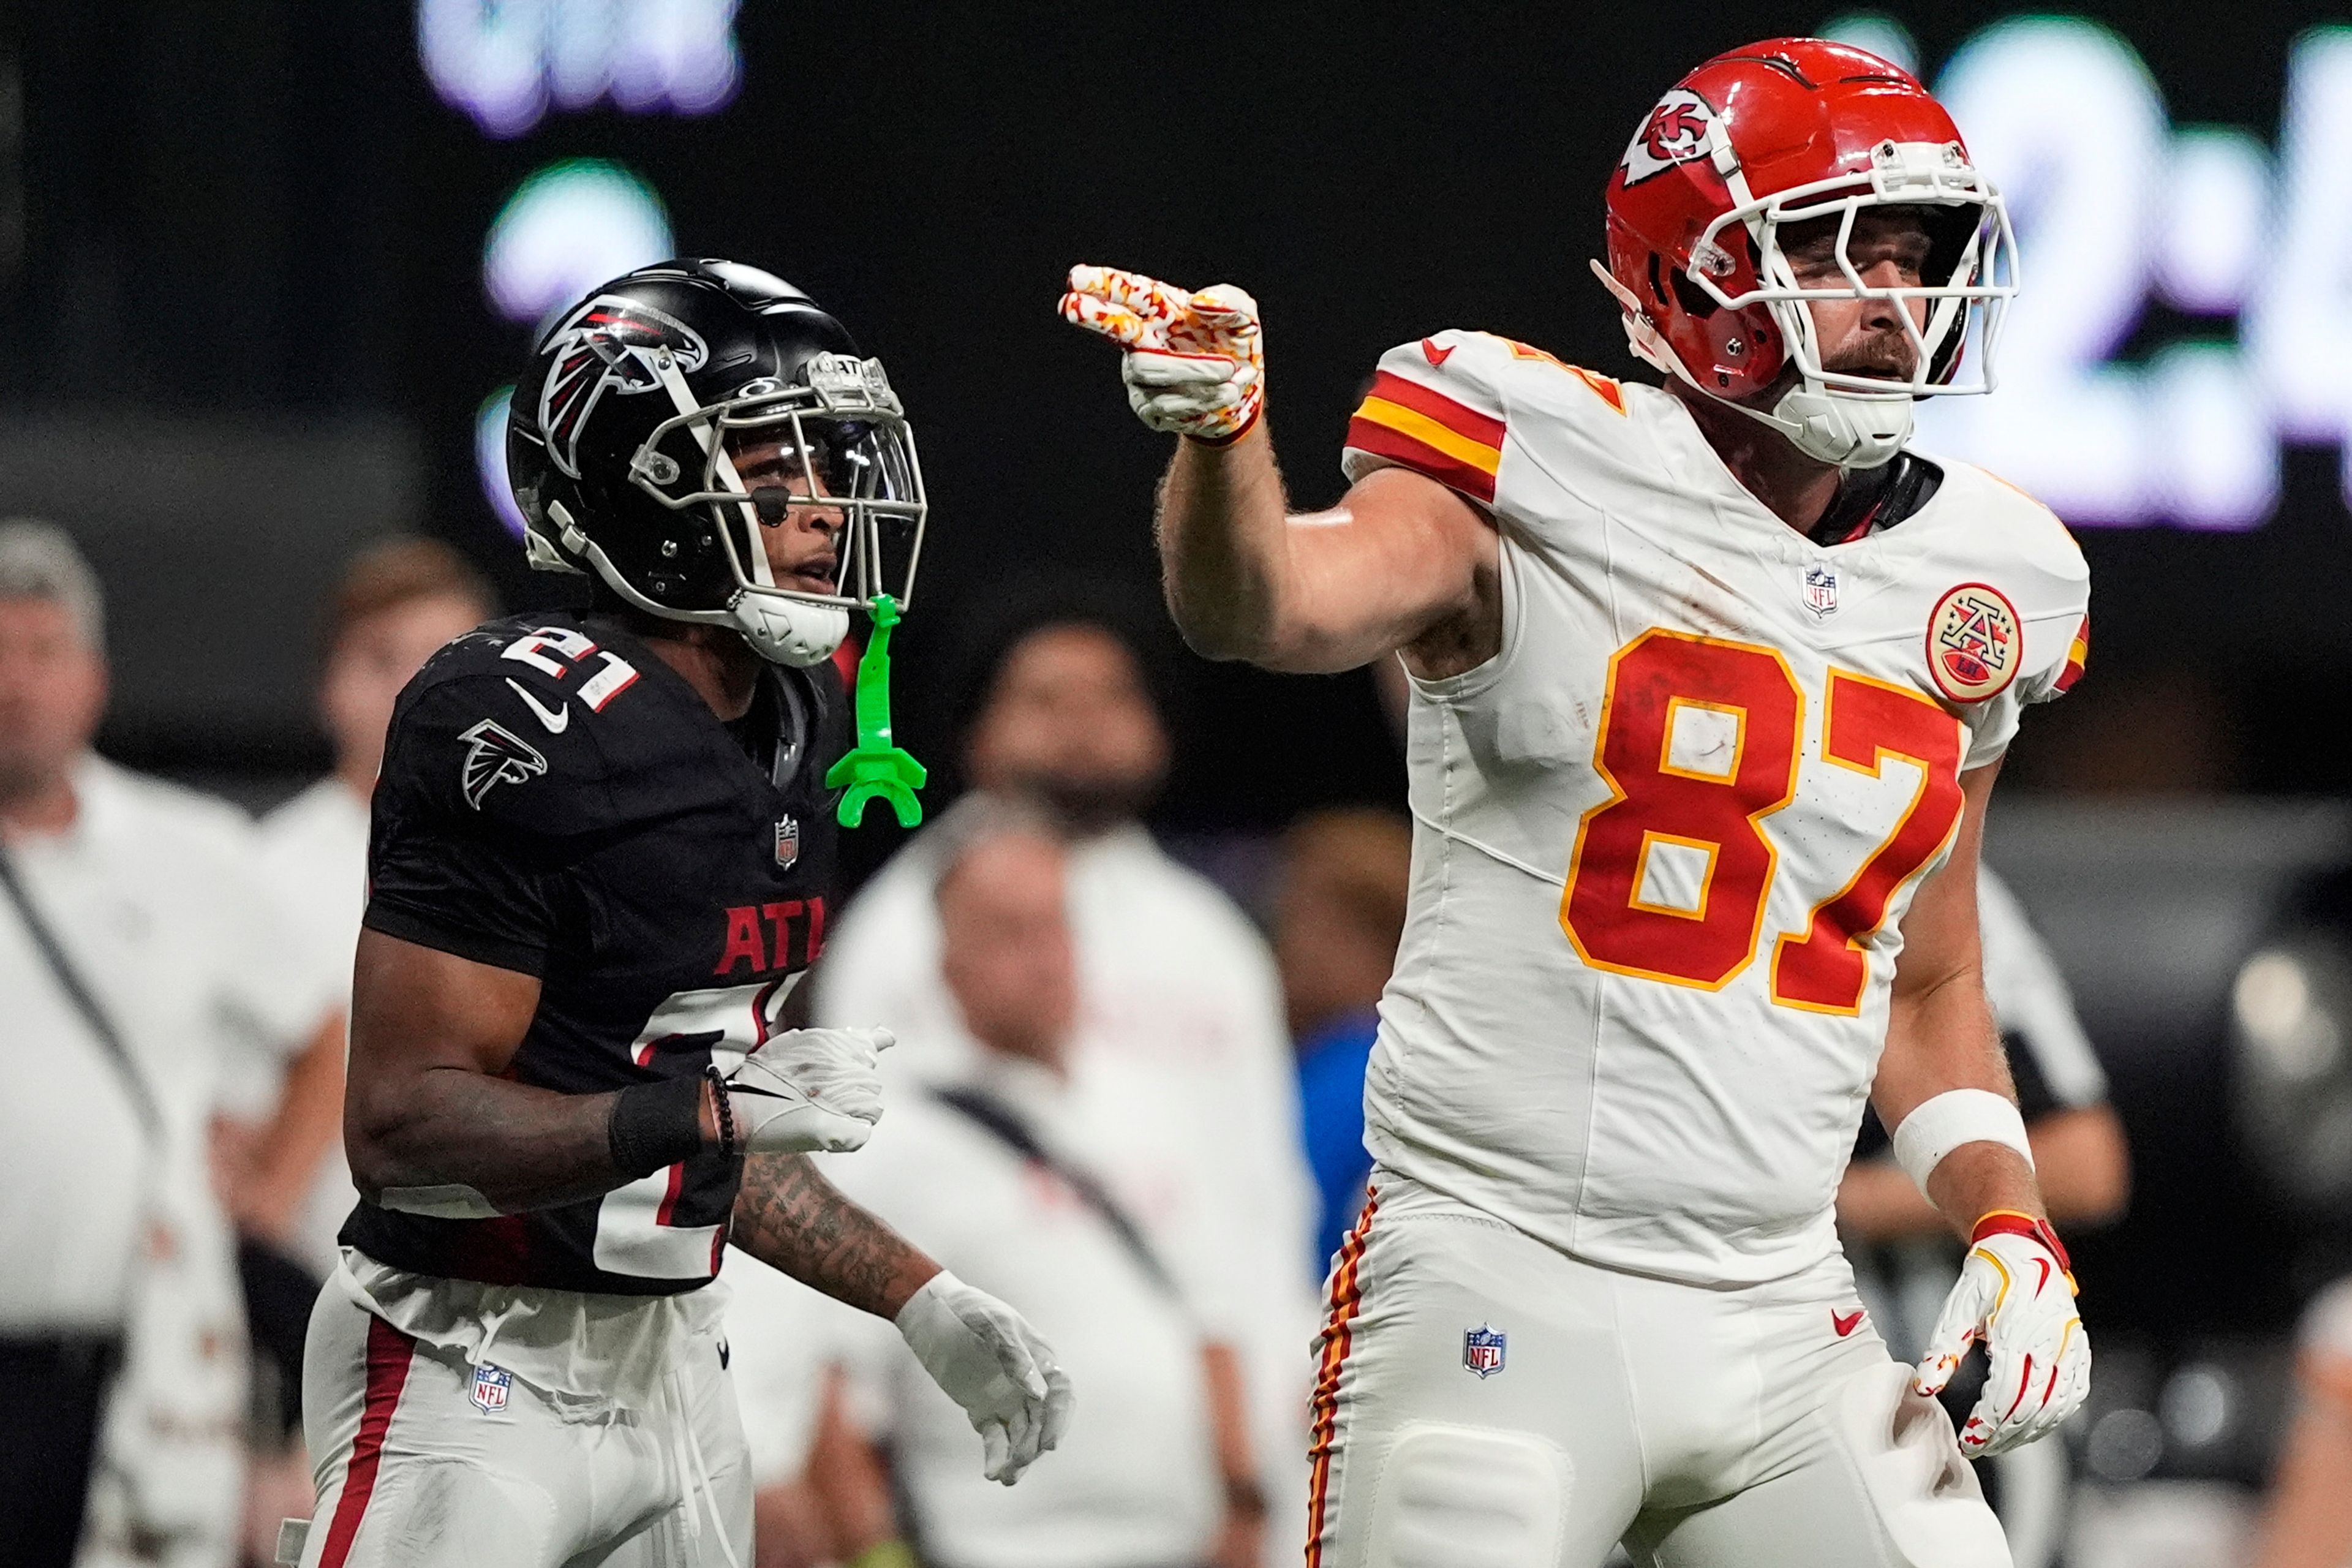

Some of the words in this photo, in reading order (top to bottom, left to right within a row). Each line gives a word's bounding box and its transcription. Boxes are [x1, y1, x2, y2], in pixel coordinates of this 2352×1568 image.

[1808, 586, 1834, 607] NFL
[1940, 597, 2005, 670] A
[500, 626, 641, 714] 21
[1558, 626, 1966, 1018] 87
[1469, 1348, 1499, 1368] NFL
[477, 1383, 505, 1405] NFL
